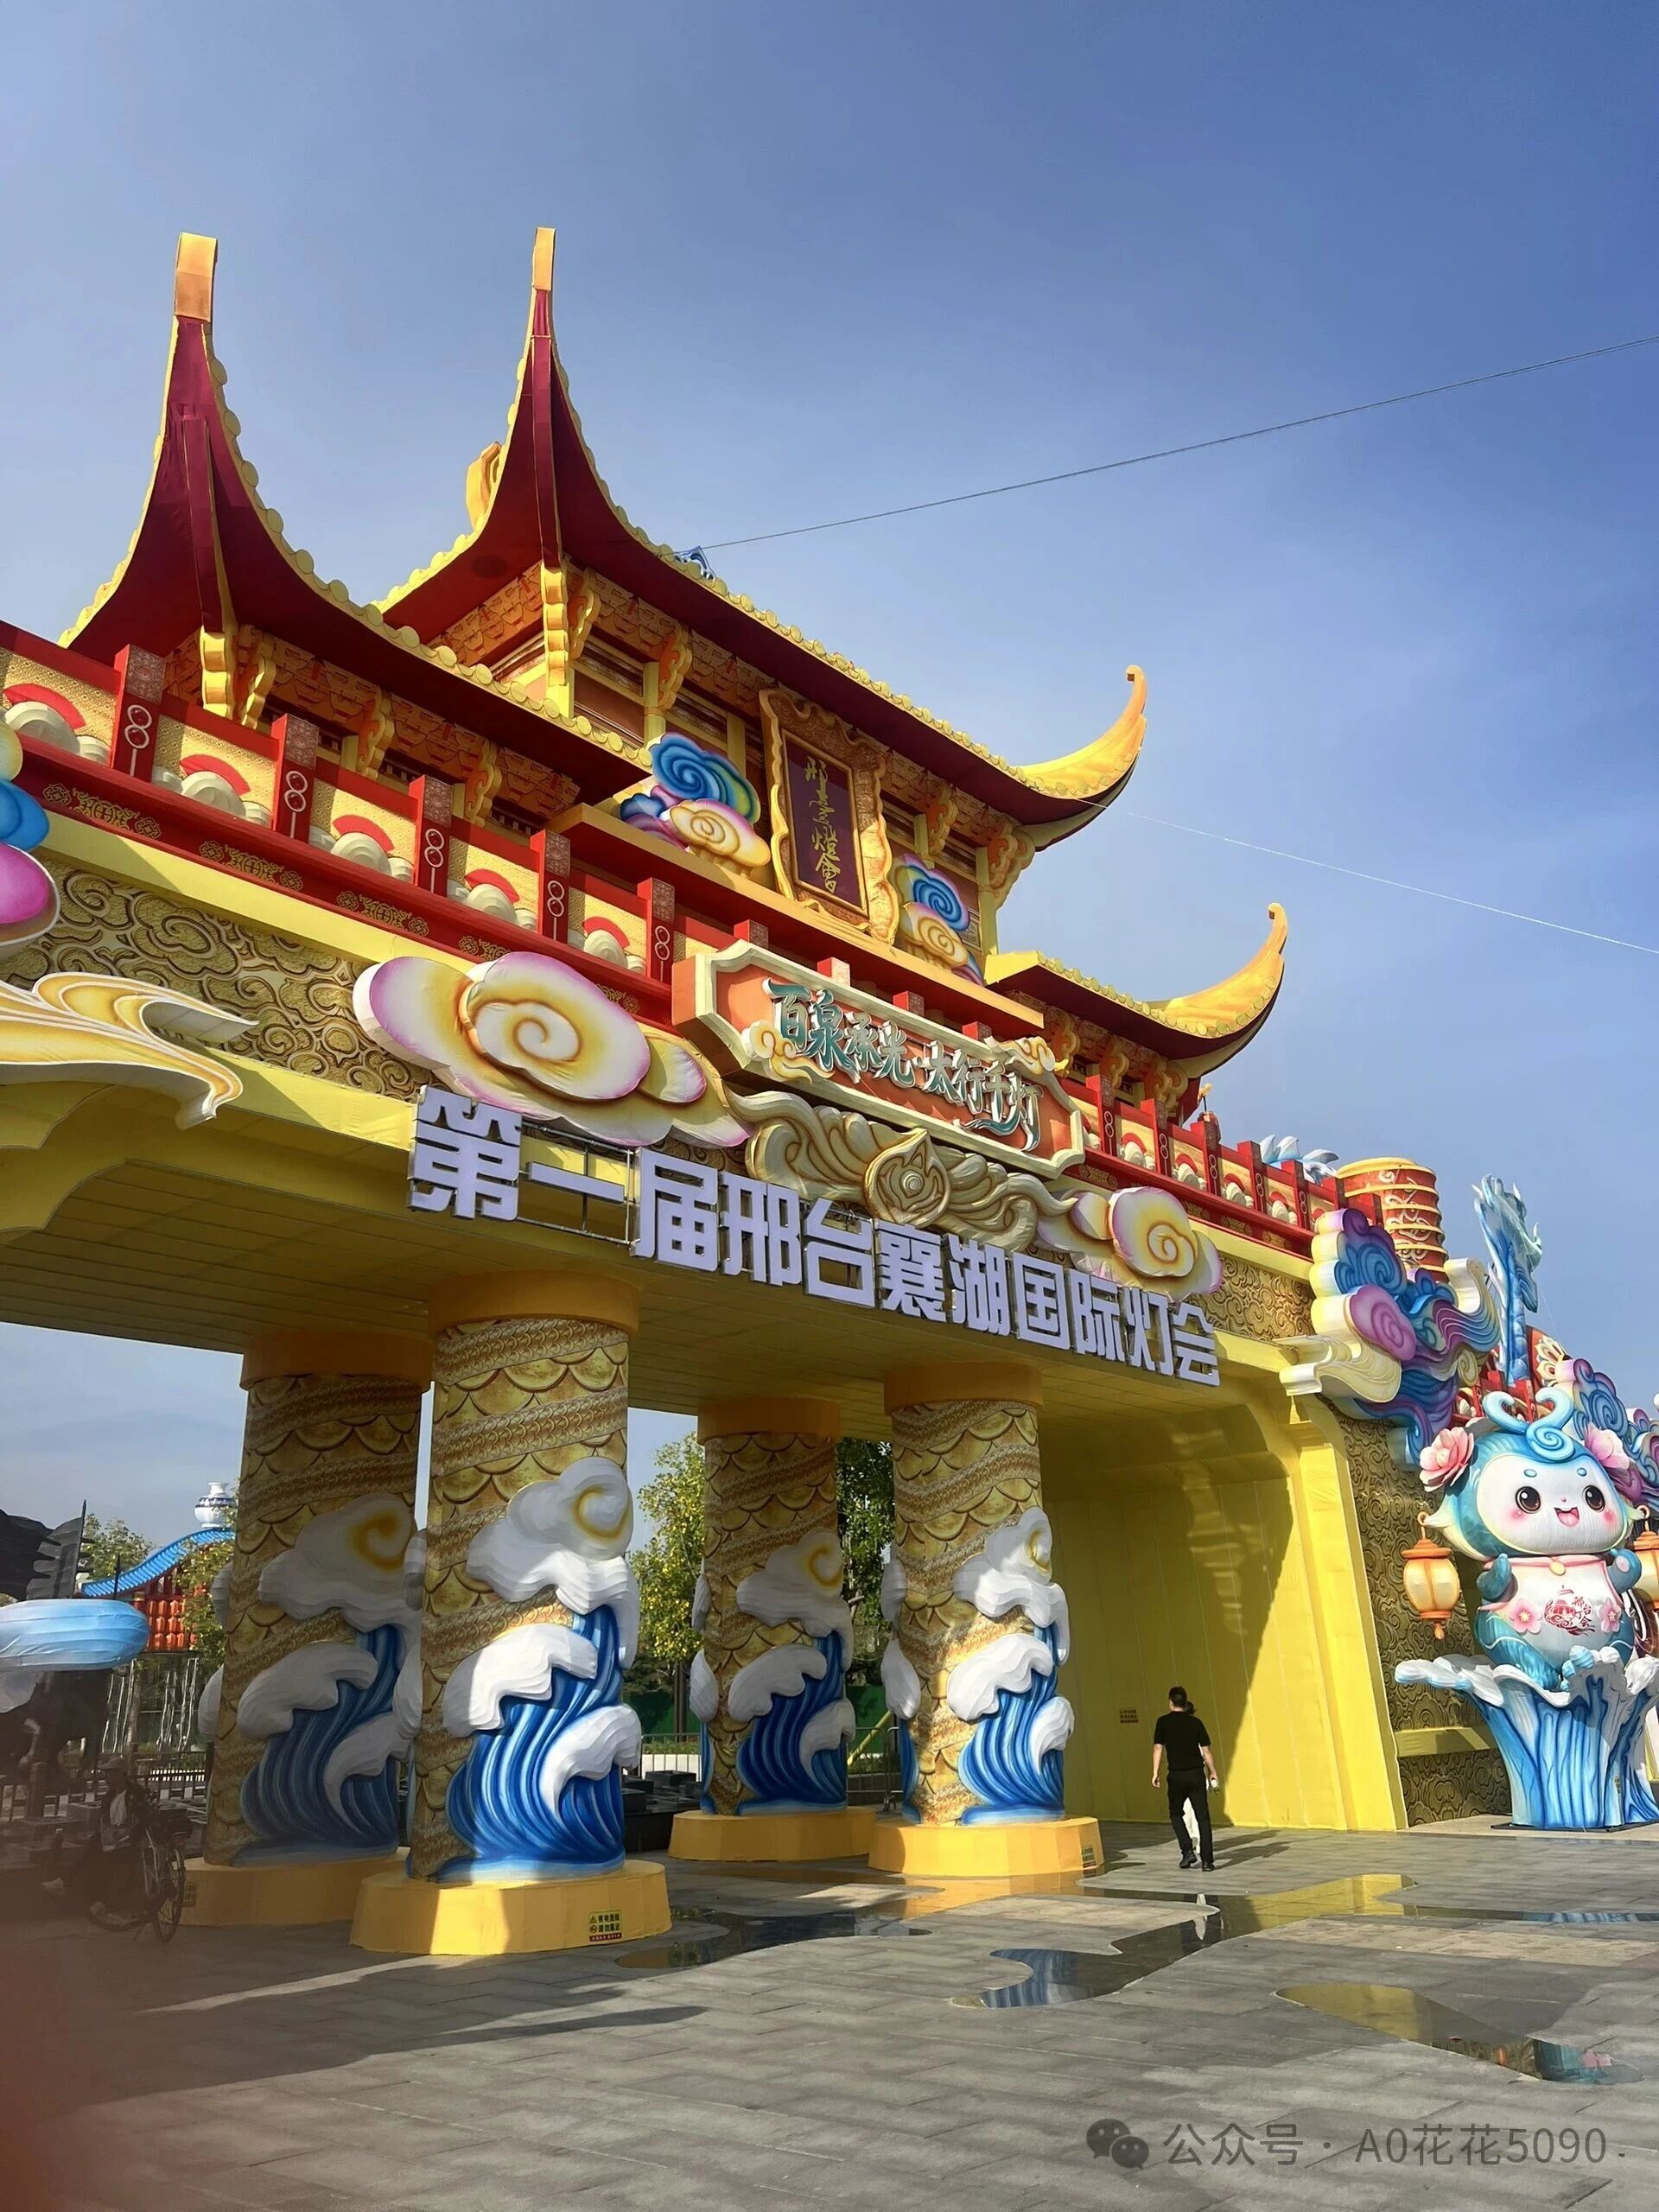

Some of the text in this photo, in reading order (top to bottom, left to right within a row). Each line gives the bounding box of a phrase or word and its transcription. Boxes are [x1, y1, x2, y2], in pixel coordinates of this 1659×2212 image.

[408, 1084, 1221, 1387] 第一届邢台襄湖国际灯会
